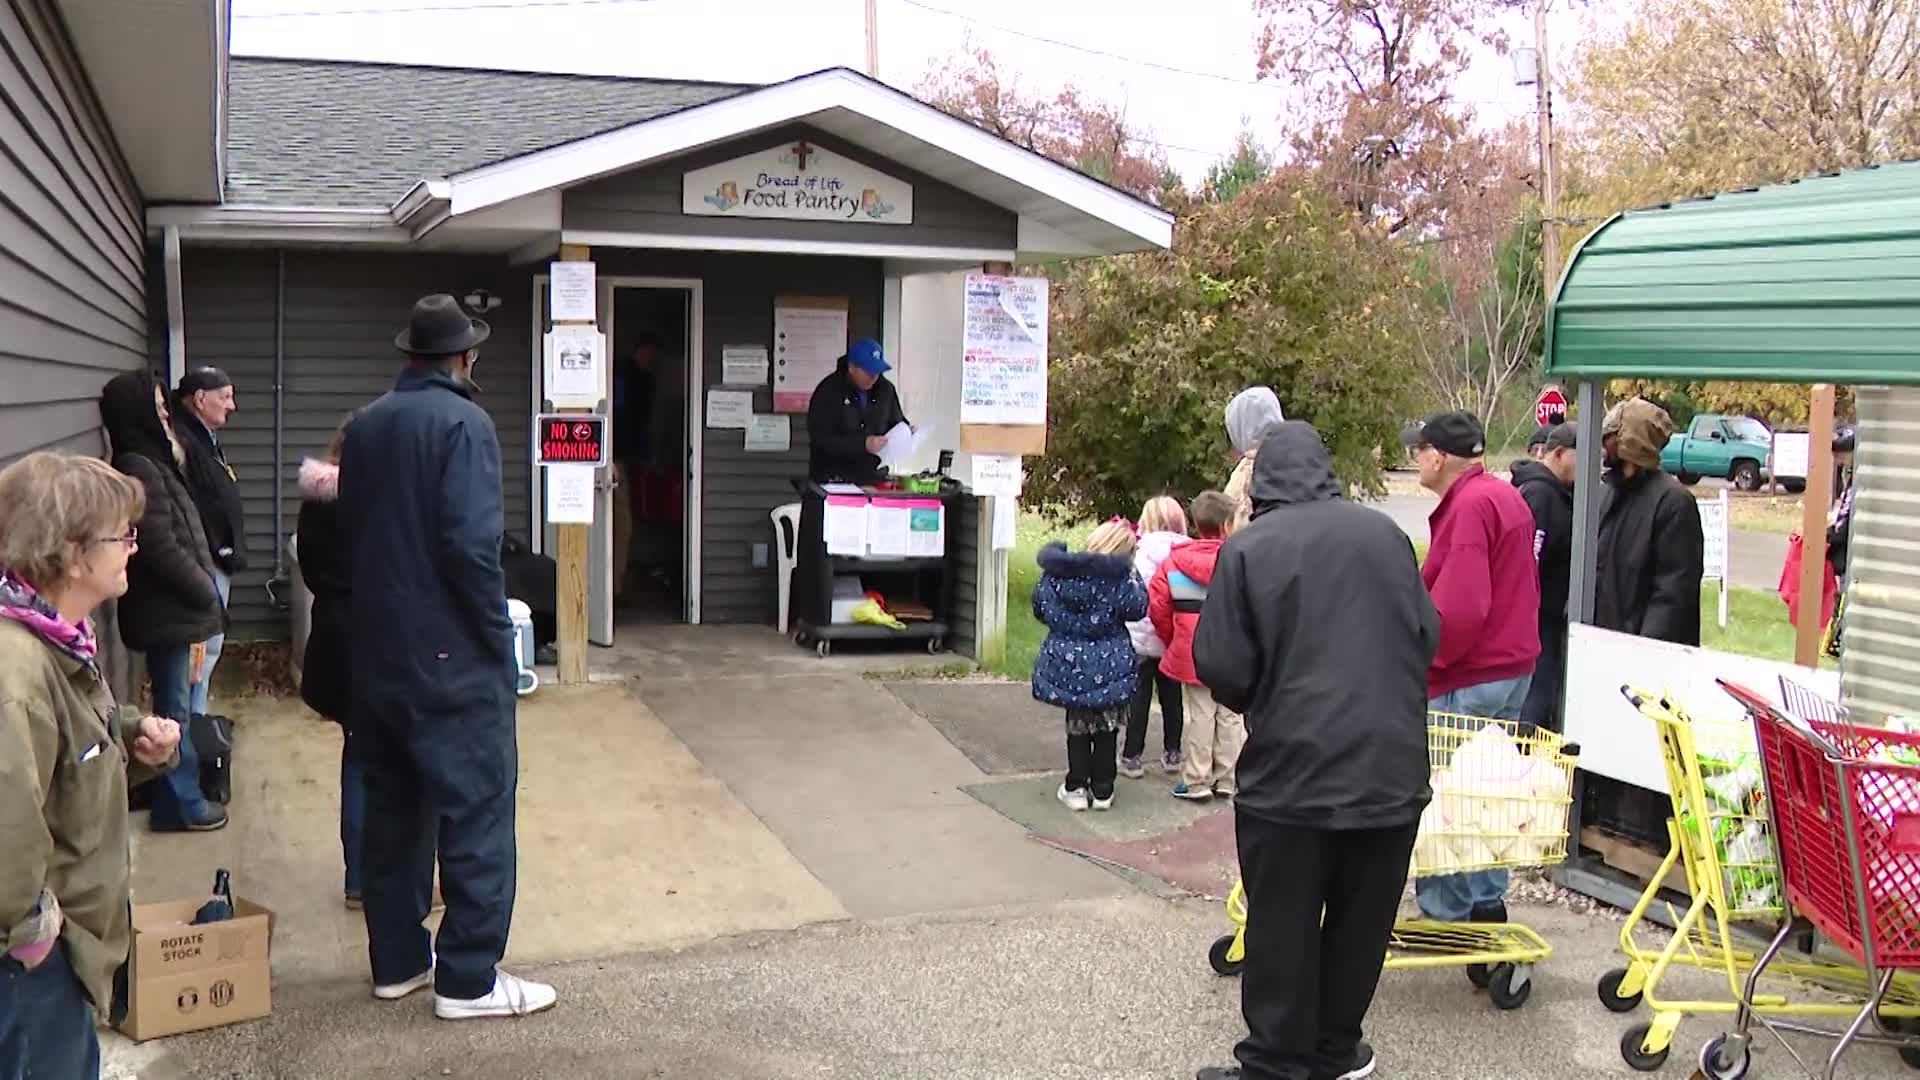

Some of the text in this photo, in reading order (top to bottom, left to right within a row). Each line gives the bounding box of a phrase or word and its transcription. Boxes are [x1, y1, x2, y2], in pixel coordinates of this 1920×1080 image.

[756, 173, 843, 190] Bread of Life
[743, 189, 859, 219] Food Pantry
[551, 423, 568, 440] NO
[543, 442, 599, 460] SMOKING
[161, 934, 204, 945] ROTATE
[164, 946, 201, 961] STOCK
